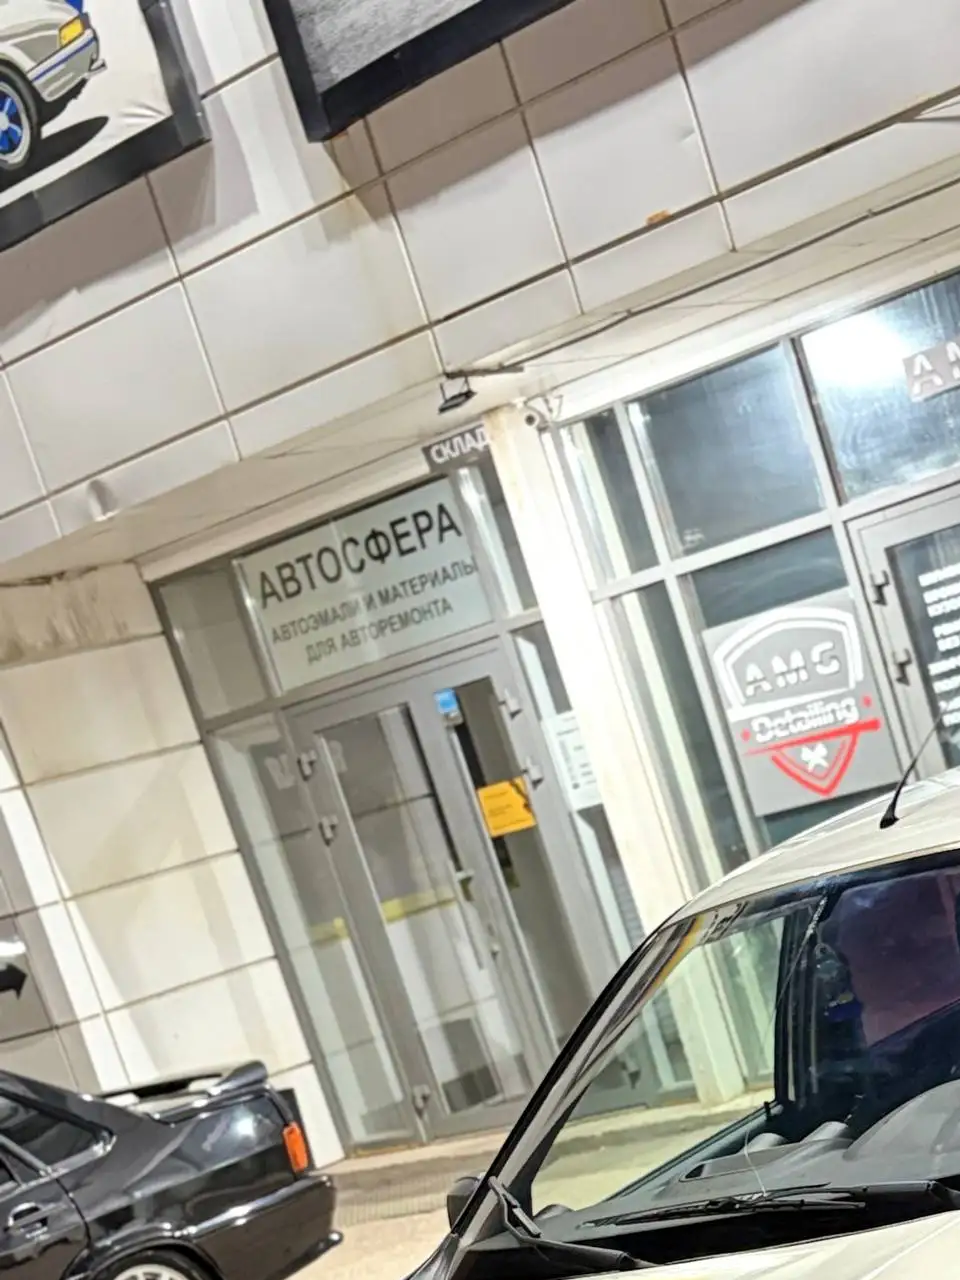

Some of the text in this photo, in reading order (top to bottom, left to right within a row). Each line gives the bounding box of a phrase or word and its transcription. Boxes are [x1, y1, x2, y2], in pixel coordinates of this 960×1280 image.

[430, 428, 489, 465] СКЛАД
[258, 502, 463, 610] АВТОСФЕРА
[271, 556, 479, 645] АВТОЭМАЛИ И МАТЕРИАЛЫ
[304, 597, 454, 666] ДЛЯ АВТОРЕМОНТА
[745, 640, 840, 697] AMG
[751, 697, 860, 743] Detailing
